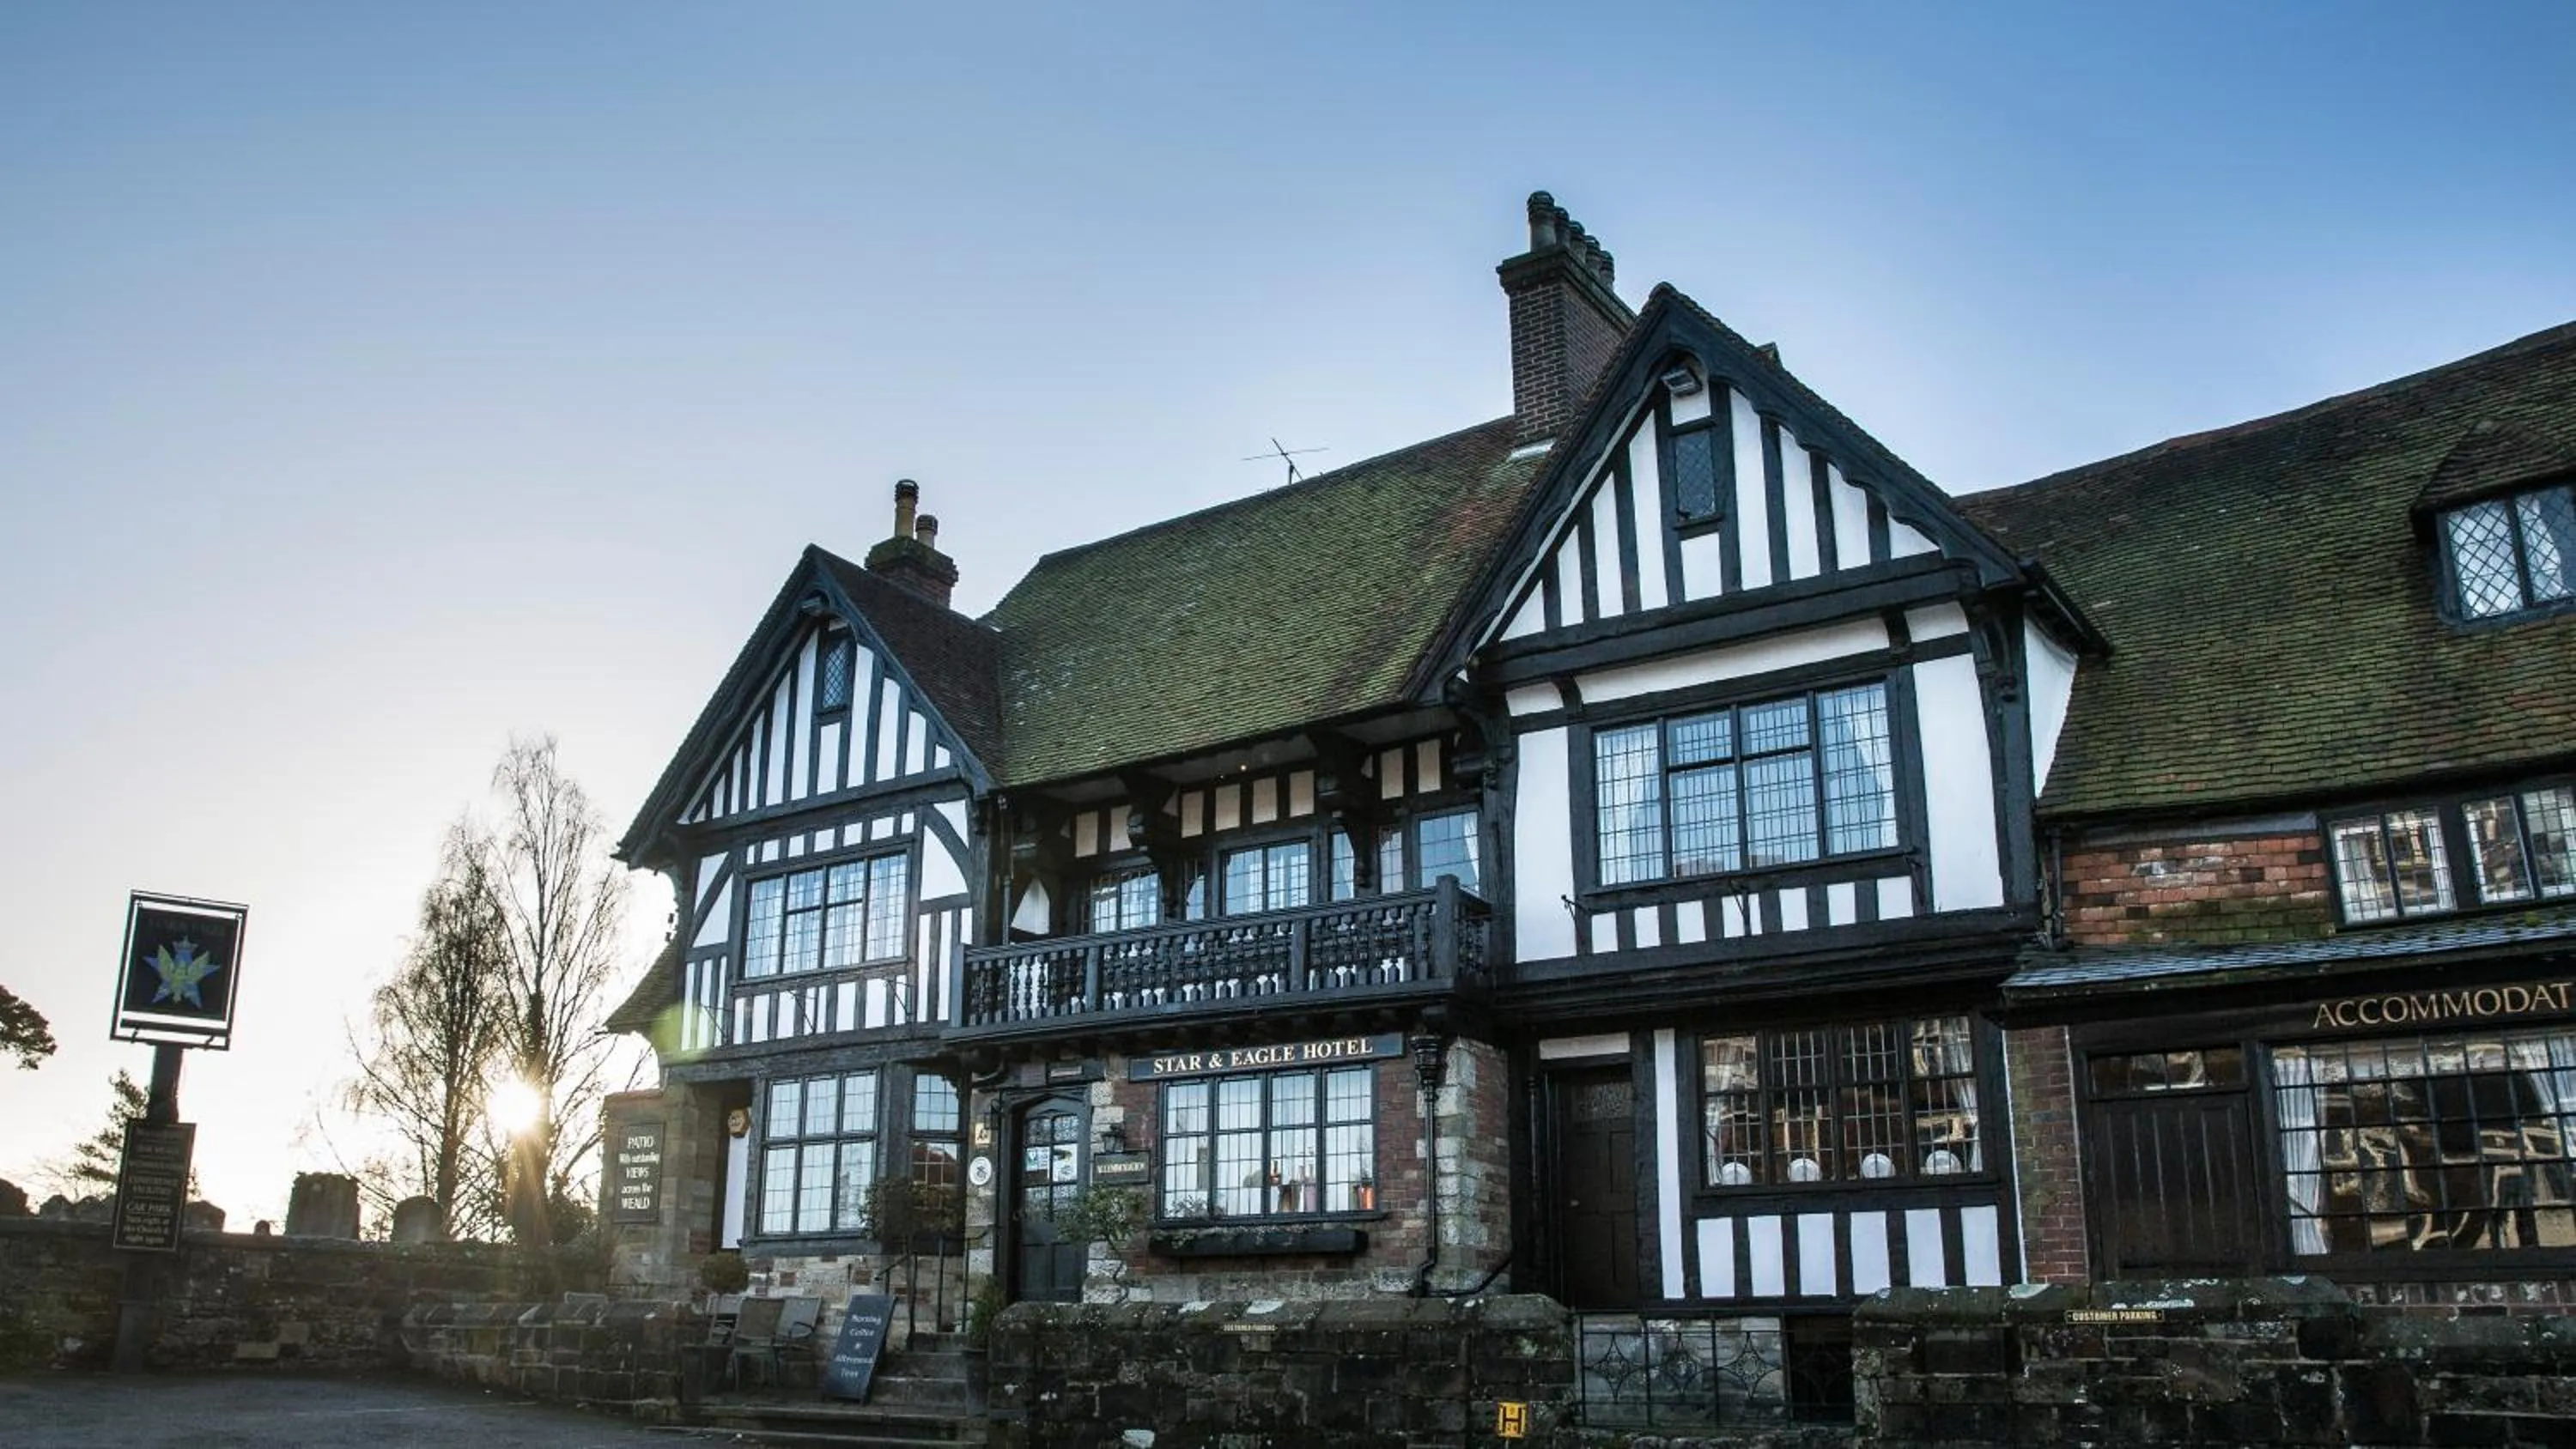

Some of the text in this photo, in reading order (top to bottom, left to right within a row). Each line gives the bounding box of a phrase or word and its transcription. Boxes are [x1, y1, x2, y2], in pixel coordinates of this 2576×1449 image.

[2312, 982, 2573, 1029] ACCOMMODAT
[1153, 1038, 1373, 1074] STAR & EAGLE HOTEL
[628, 1136, 654, 1149] PATIO
